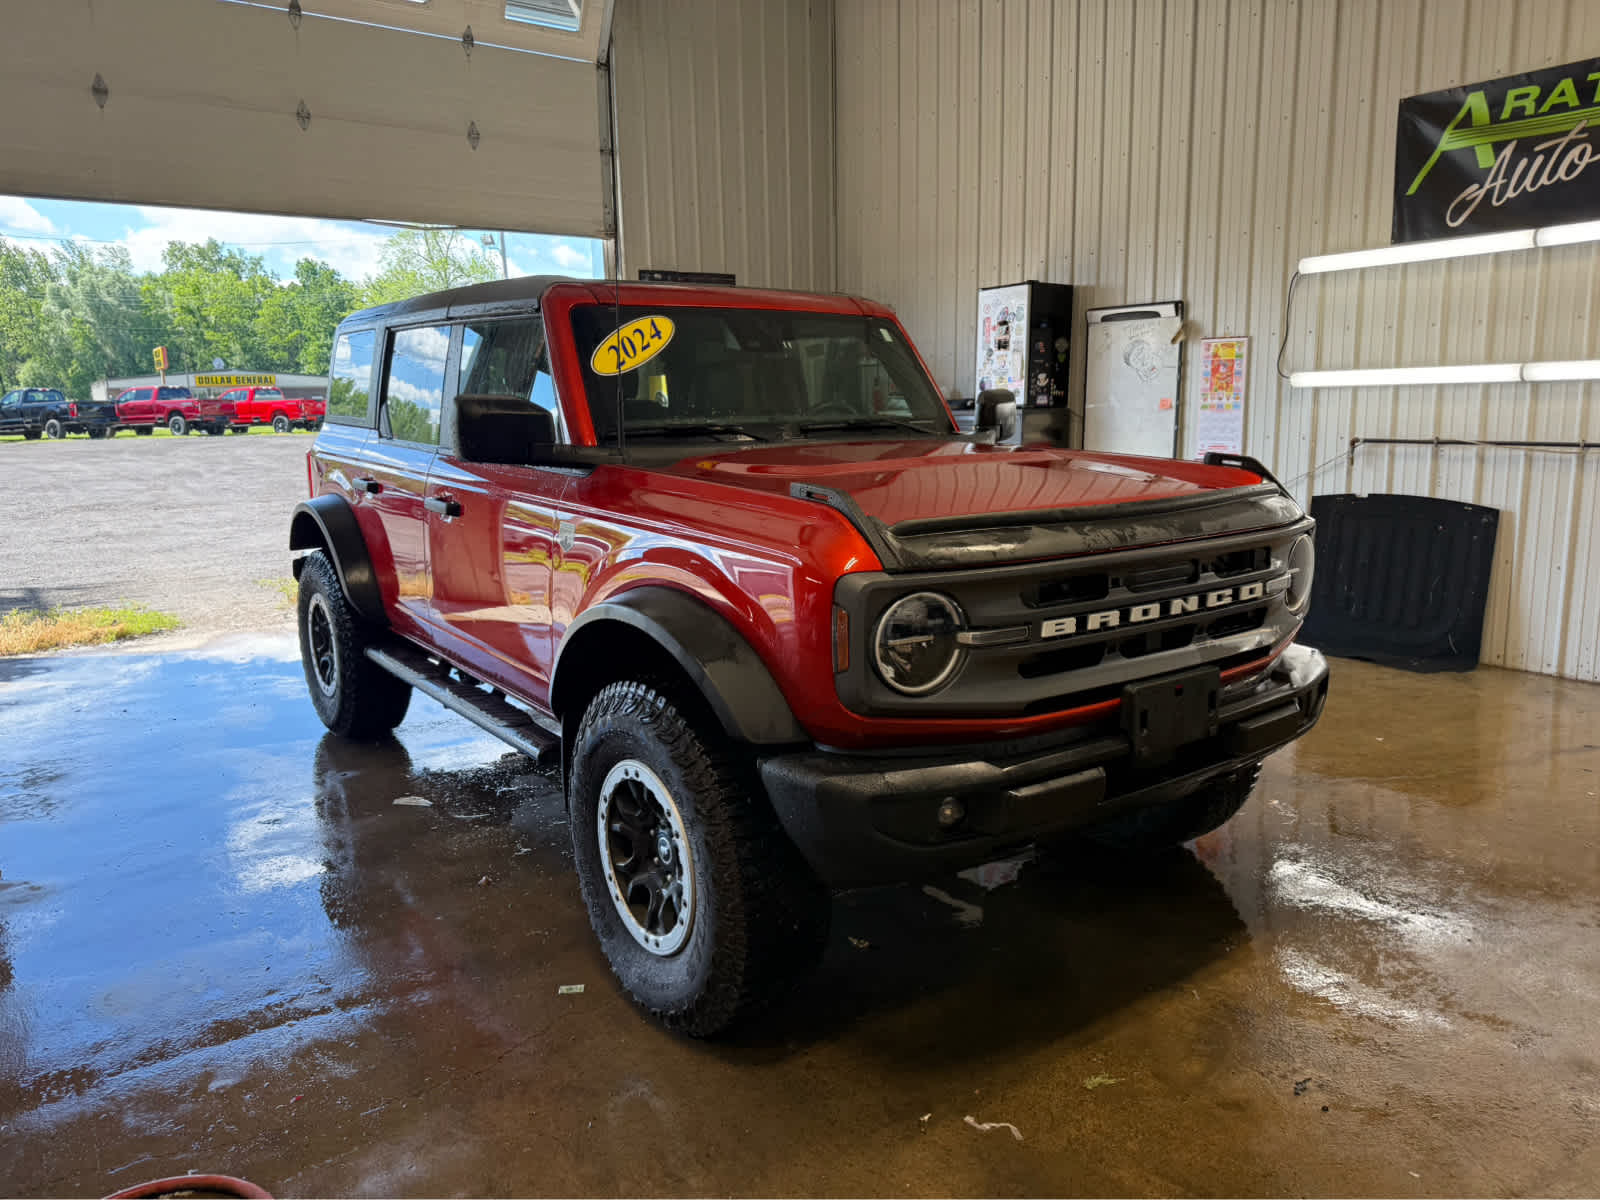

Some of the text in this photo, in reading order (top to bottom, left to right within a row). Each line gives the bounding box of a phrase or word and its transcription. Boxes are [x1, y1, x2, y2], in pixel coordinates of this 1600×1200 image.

[1446, 120, 1600, 227] Auto
[607, 318, 662, 370] 2024
[198, 375, 273, 385] DOLLAR GENERAL
[1041, 582, 1264, 638] BRONCO
